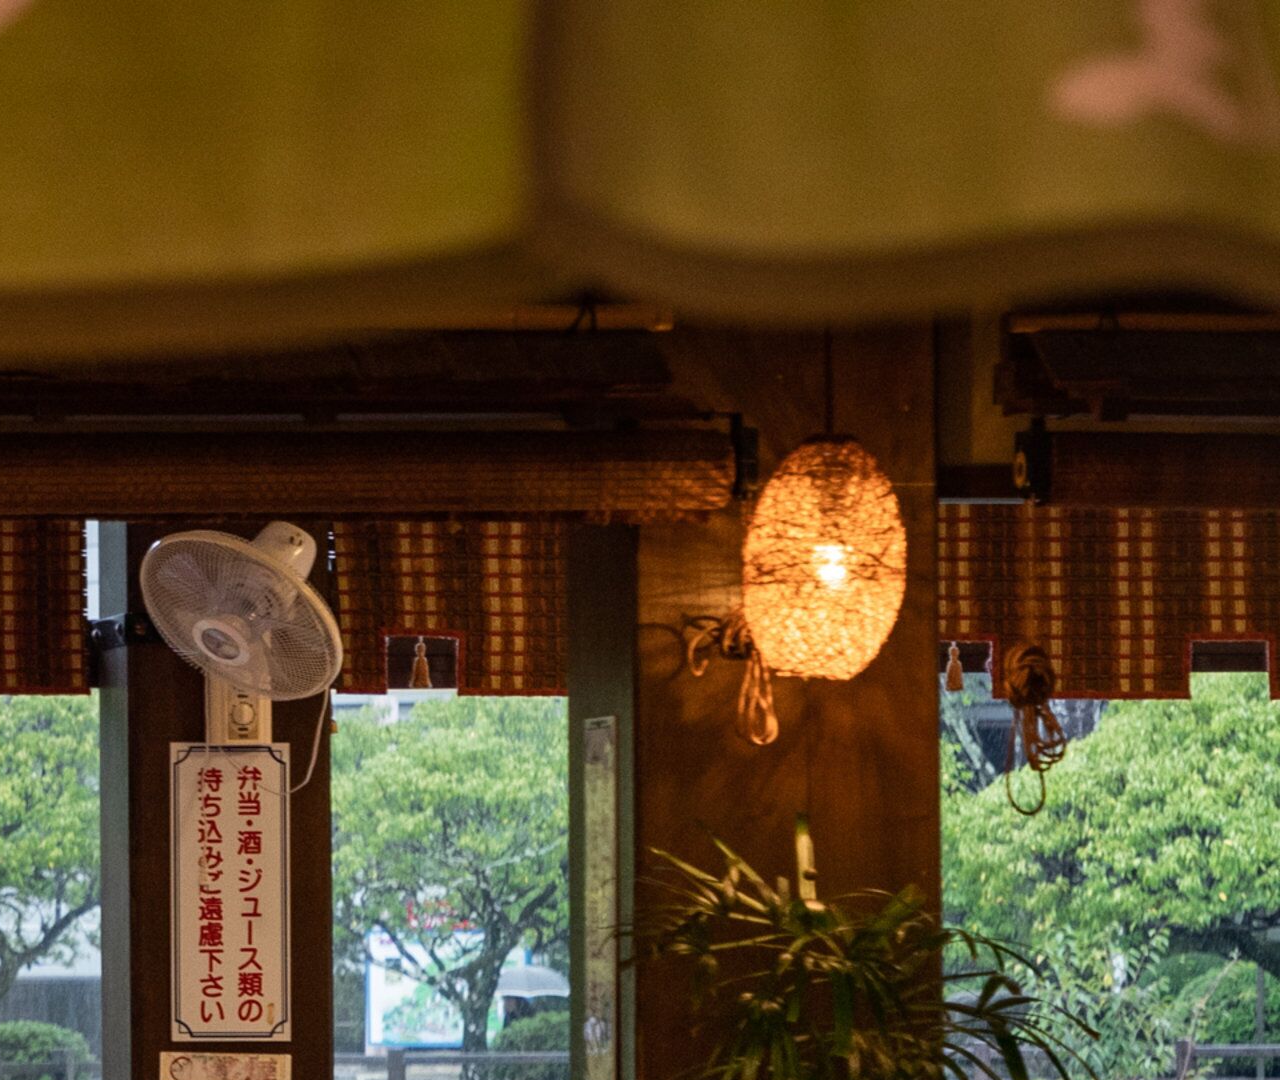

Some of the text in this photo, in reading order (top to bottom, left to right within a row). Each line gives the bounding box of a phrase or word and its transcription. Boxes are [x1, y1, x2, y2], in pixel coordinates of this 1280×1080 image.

[197, 766, 226, 1024] 持ち込みご遠慮下さい
[236, 764, 264, 1023] 弁当・酒・ジュース類の
